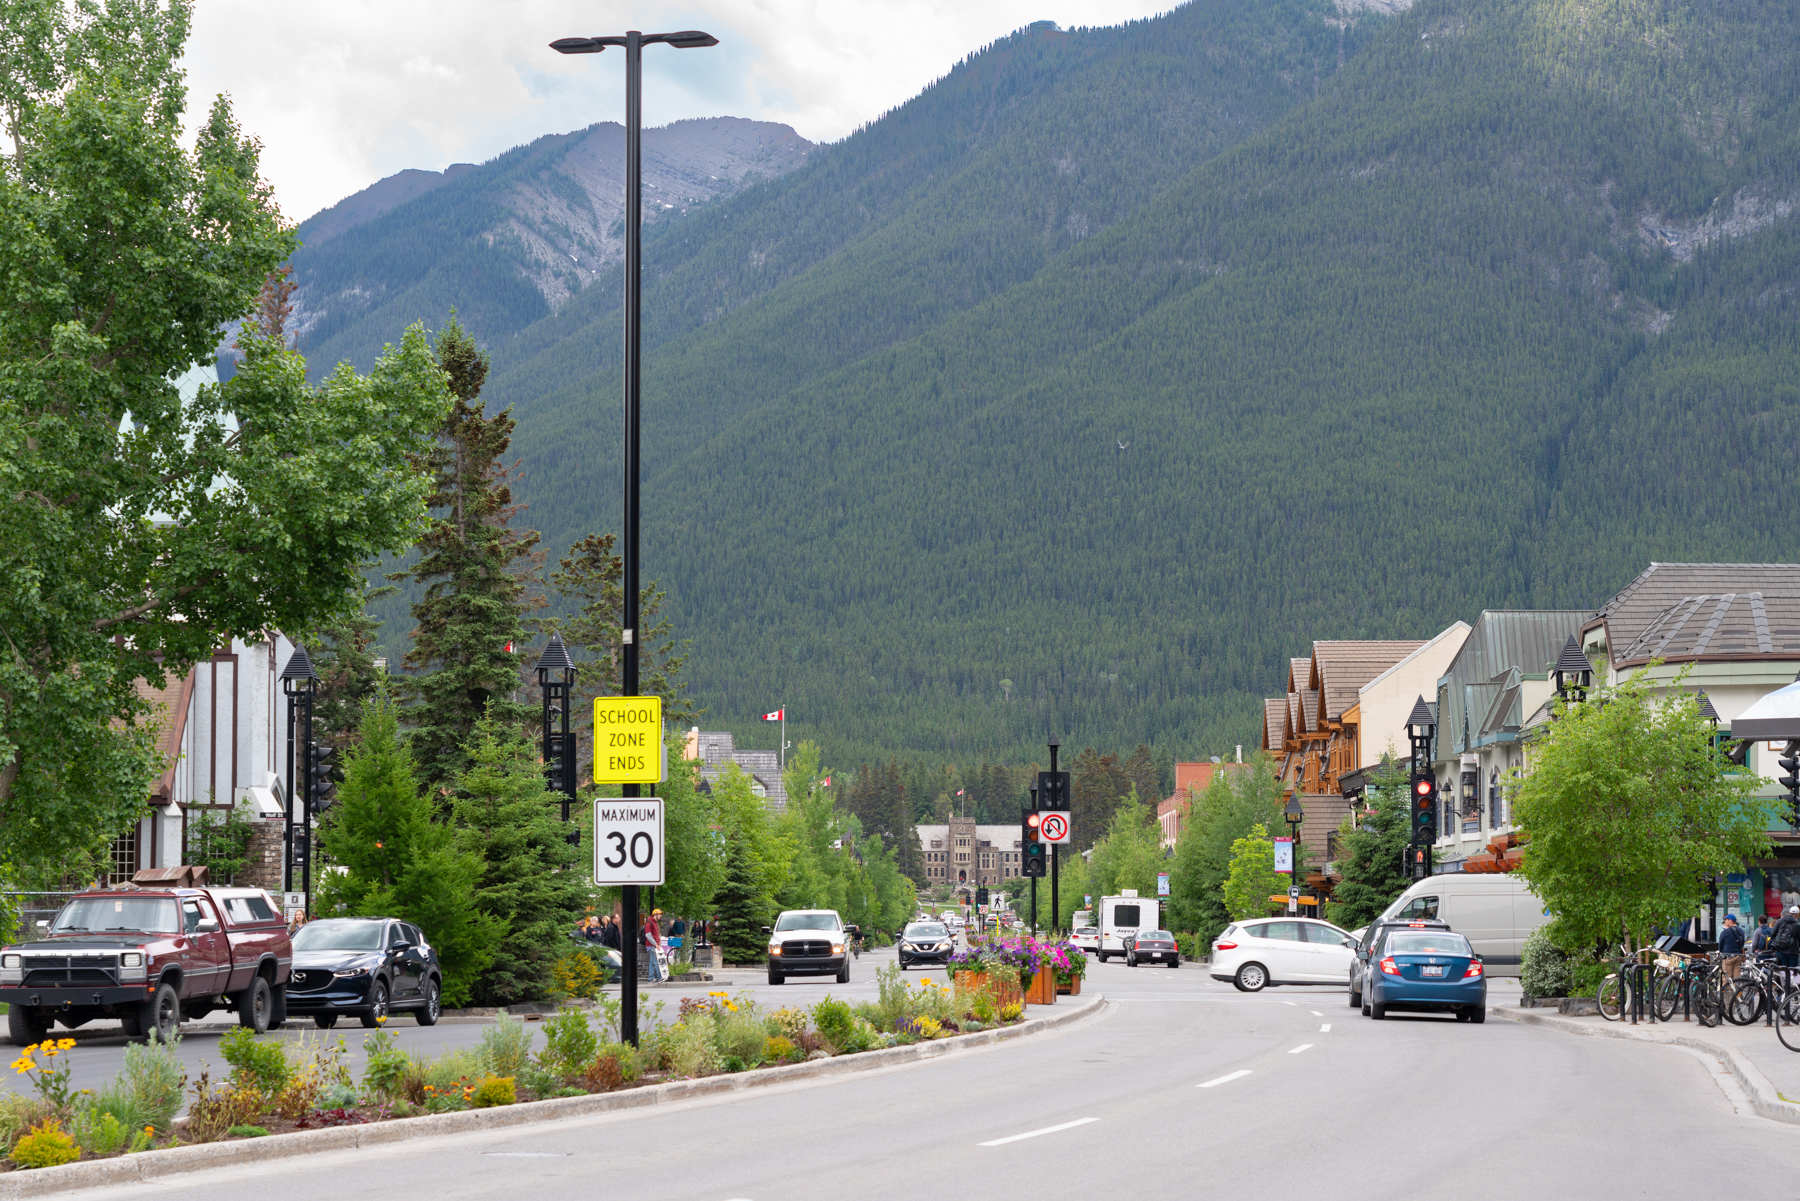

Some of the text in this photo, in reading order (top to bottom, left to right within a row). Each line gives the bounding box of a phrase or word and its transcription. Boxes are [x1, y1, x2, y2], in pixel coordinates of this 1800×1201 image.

[600, 710, 655, 724] SCHOOL
[609, 733, 645, 747] ZONE
[609, 756, 645, 770] ENDS
[601, 808, 655, 821] MAXIMUM
[604, 831, 654, 868] 30
